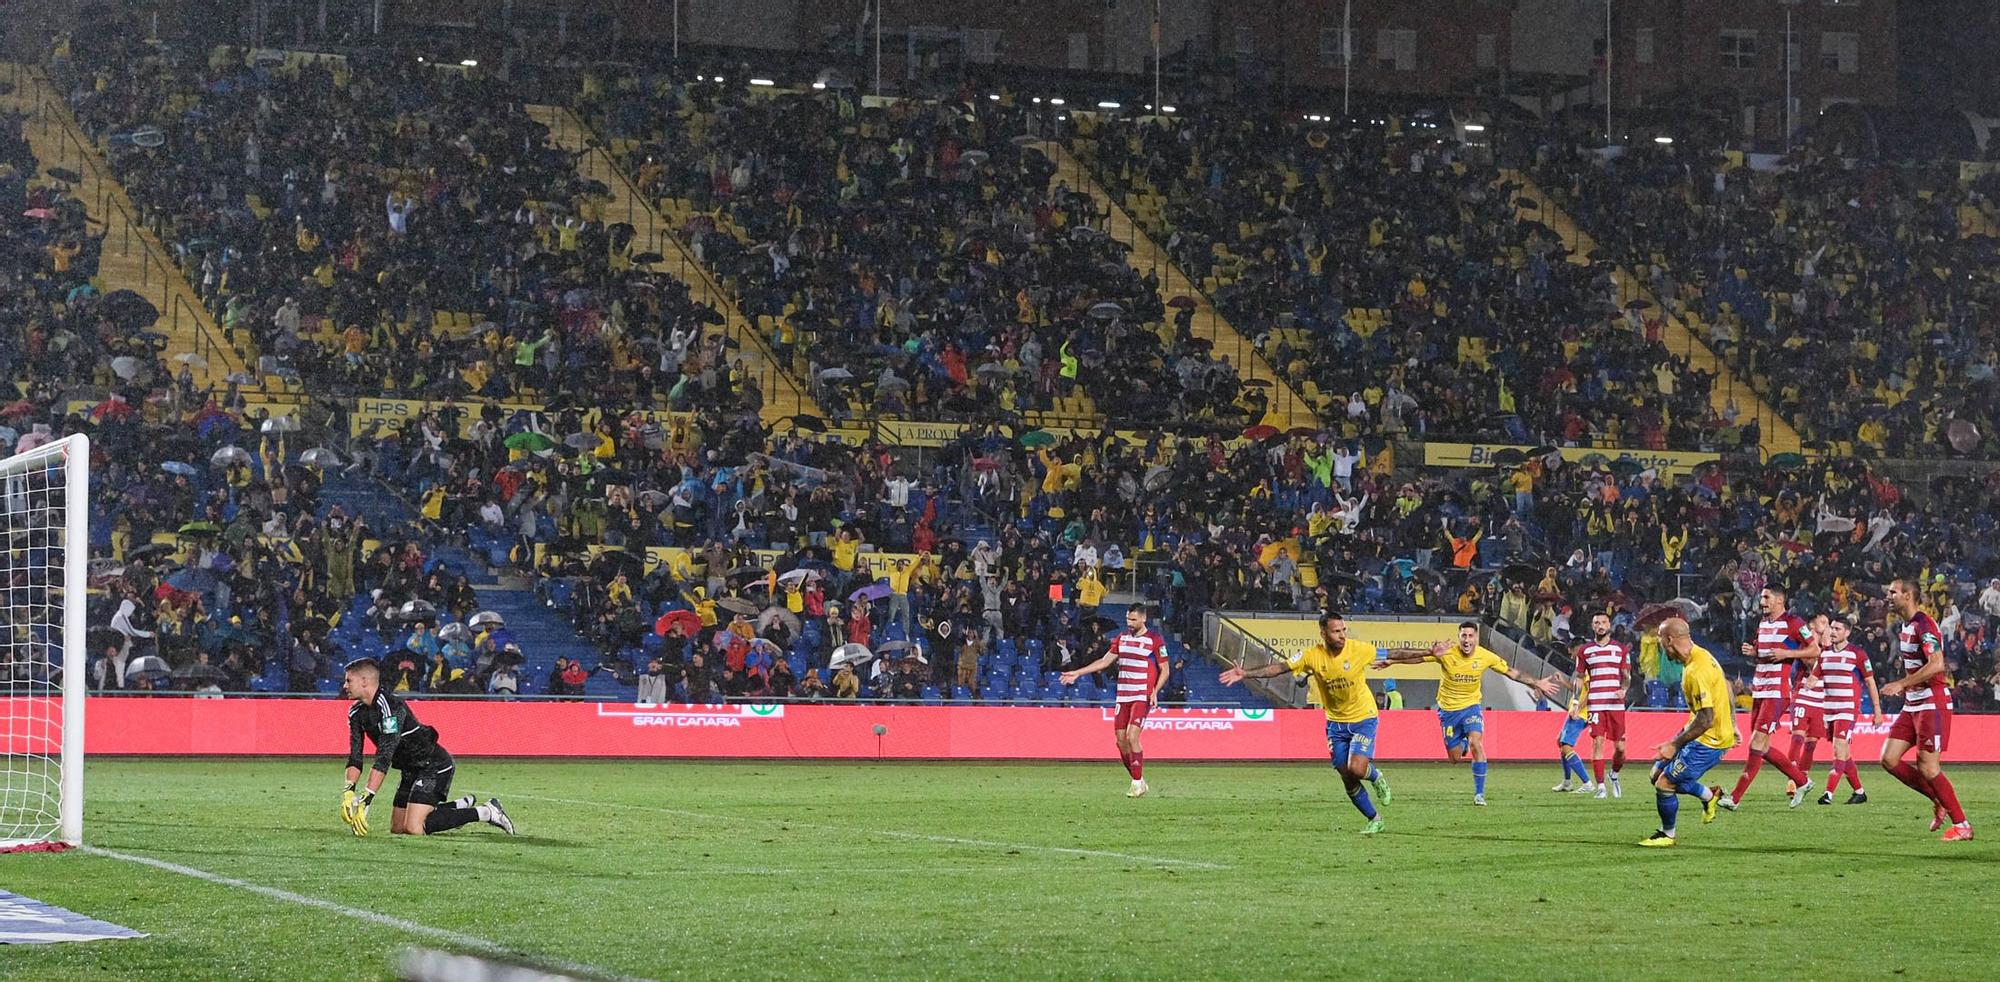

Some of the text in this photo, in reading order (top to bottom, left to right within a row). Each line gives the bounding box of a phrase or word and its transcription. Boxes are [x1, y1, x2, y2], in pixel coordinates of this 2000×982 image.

[364, 402, 408, 416] HPS
[1794, 706, 1806, 718] 18
[677, 716, 740, 728] CANARIA
[1587, 712, 1600, 725] 24
[1143, 719, 1233, 731] RAN CANARIA
